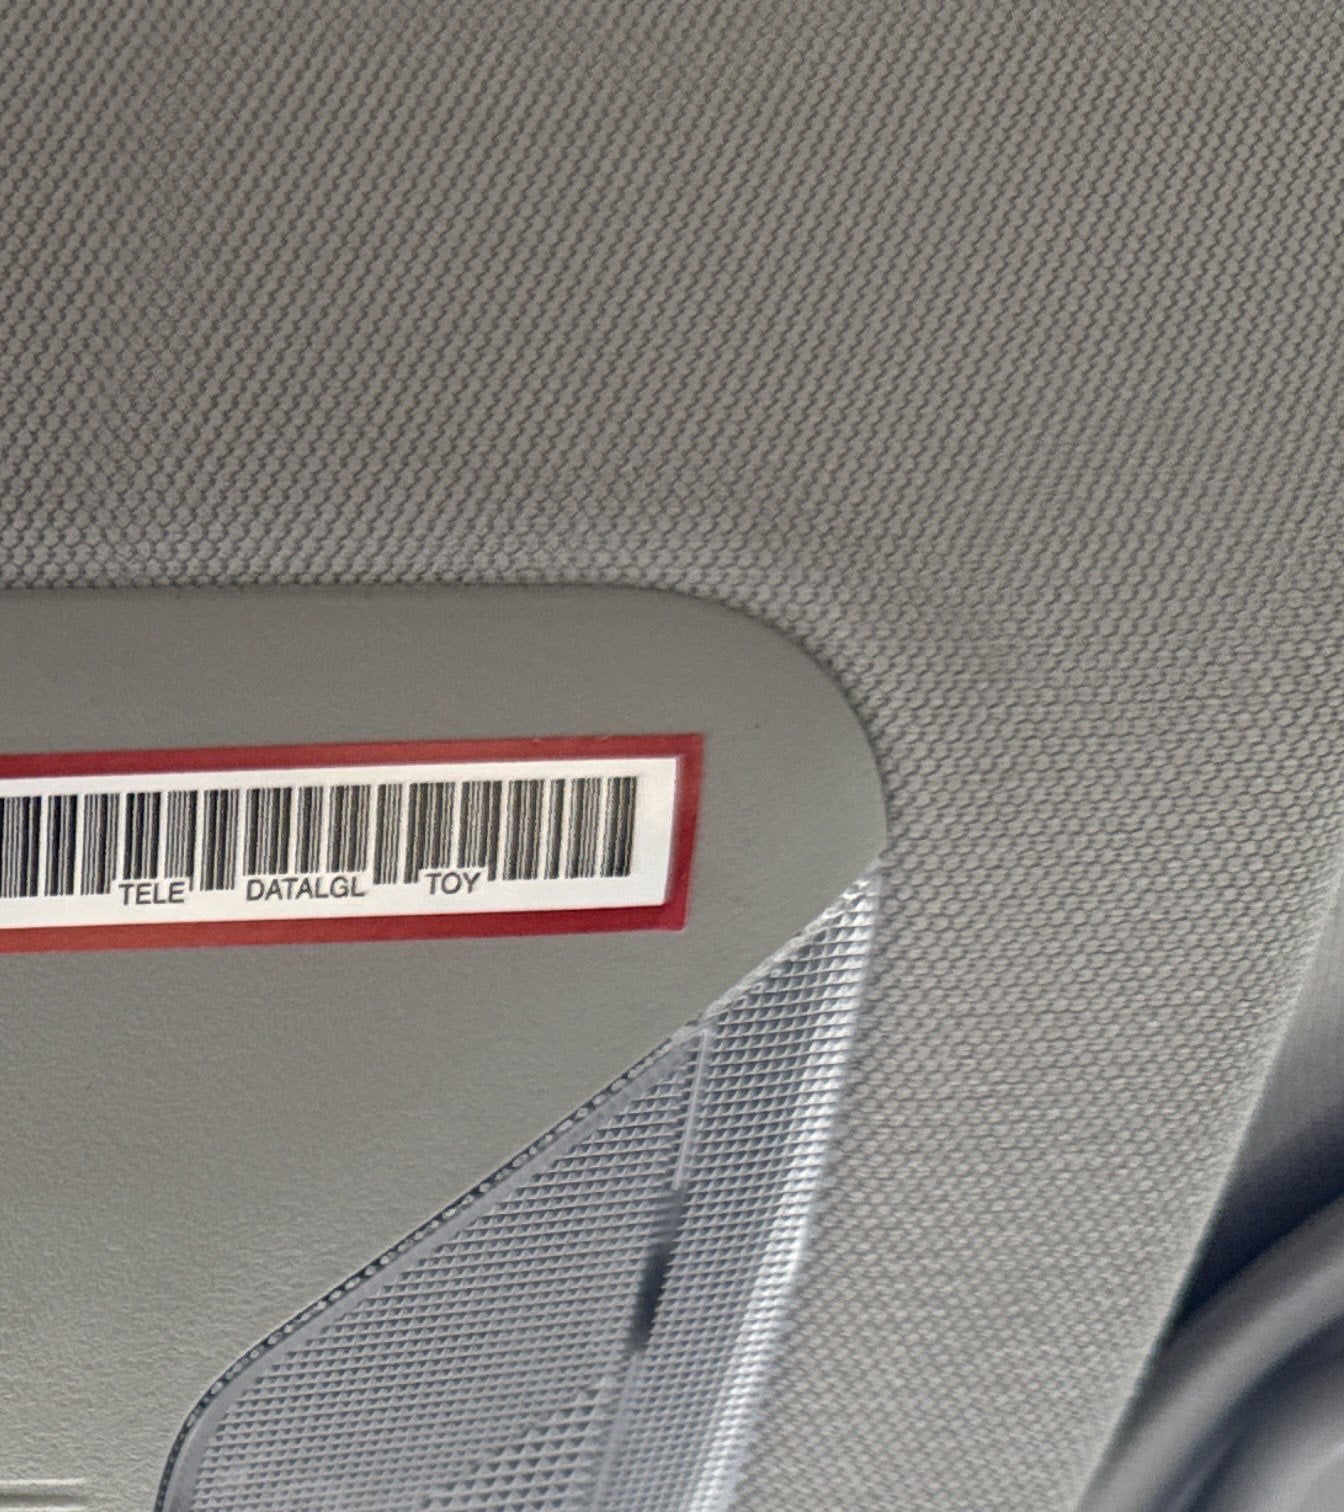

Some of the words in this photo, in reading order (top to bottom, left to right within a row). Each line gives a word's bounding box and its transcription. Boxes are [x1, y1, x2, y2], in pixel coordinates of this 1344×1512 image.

[119, 881, 185, 905] TELE
[247, 875, 366, 902] DATALGL
[424, 871, 482, 897] TOY
